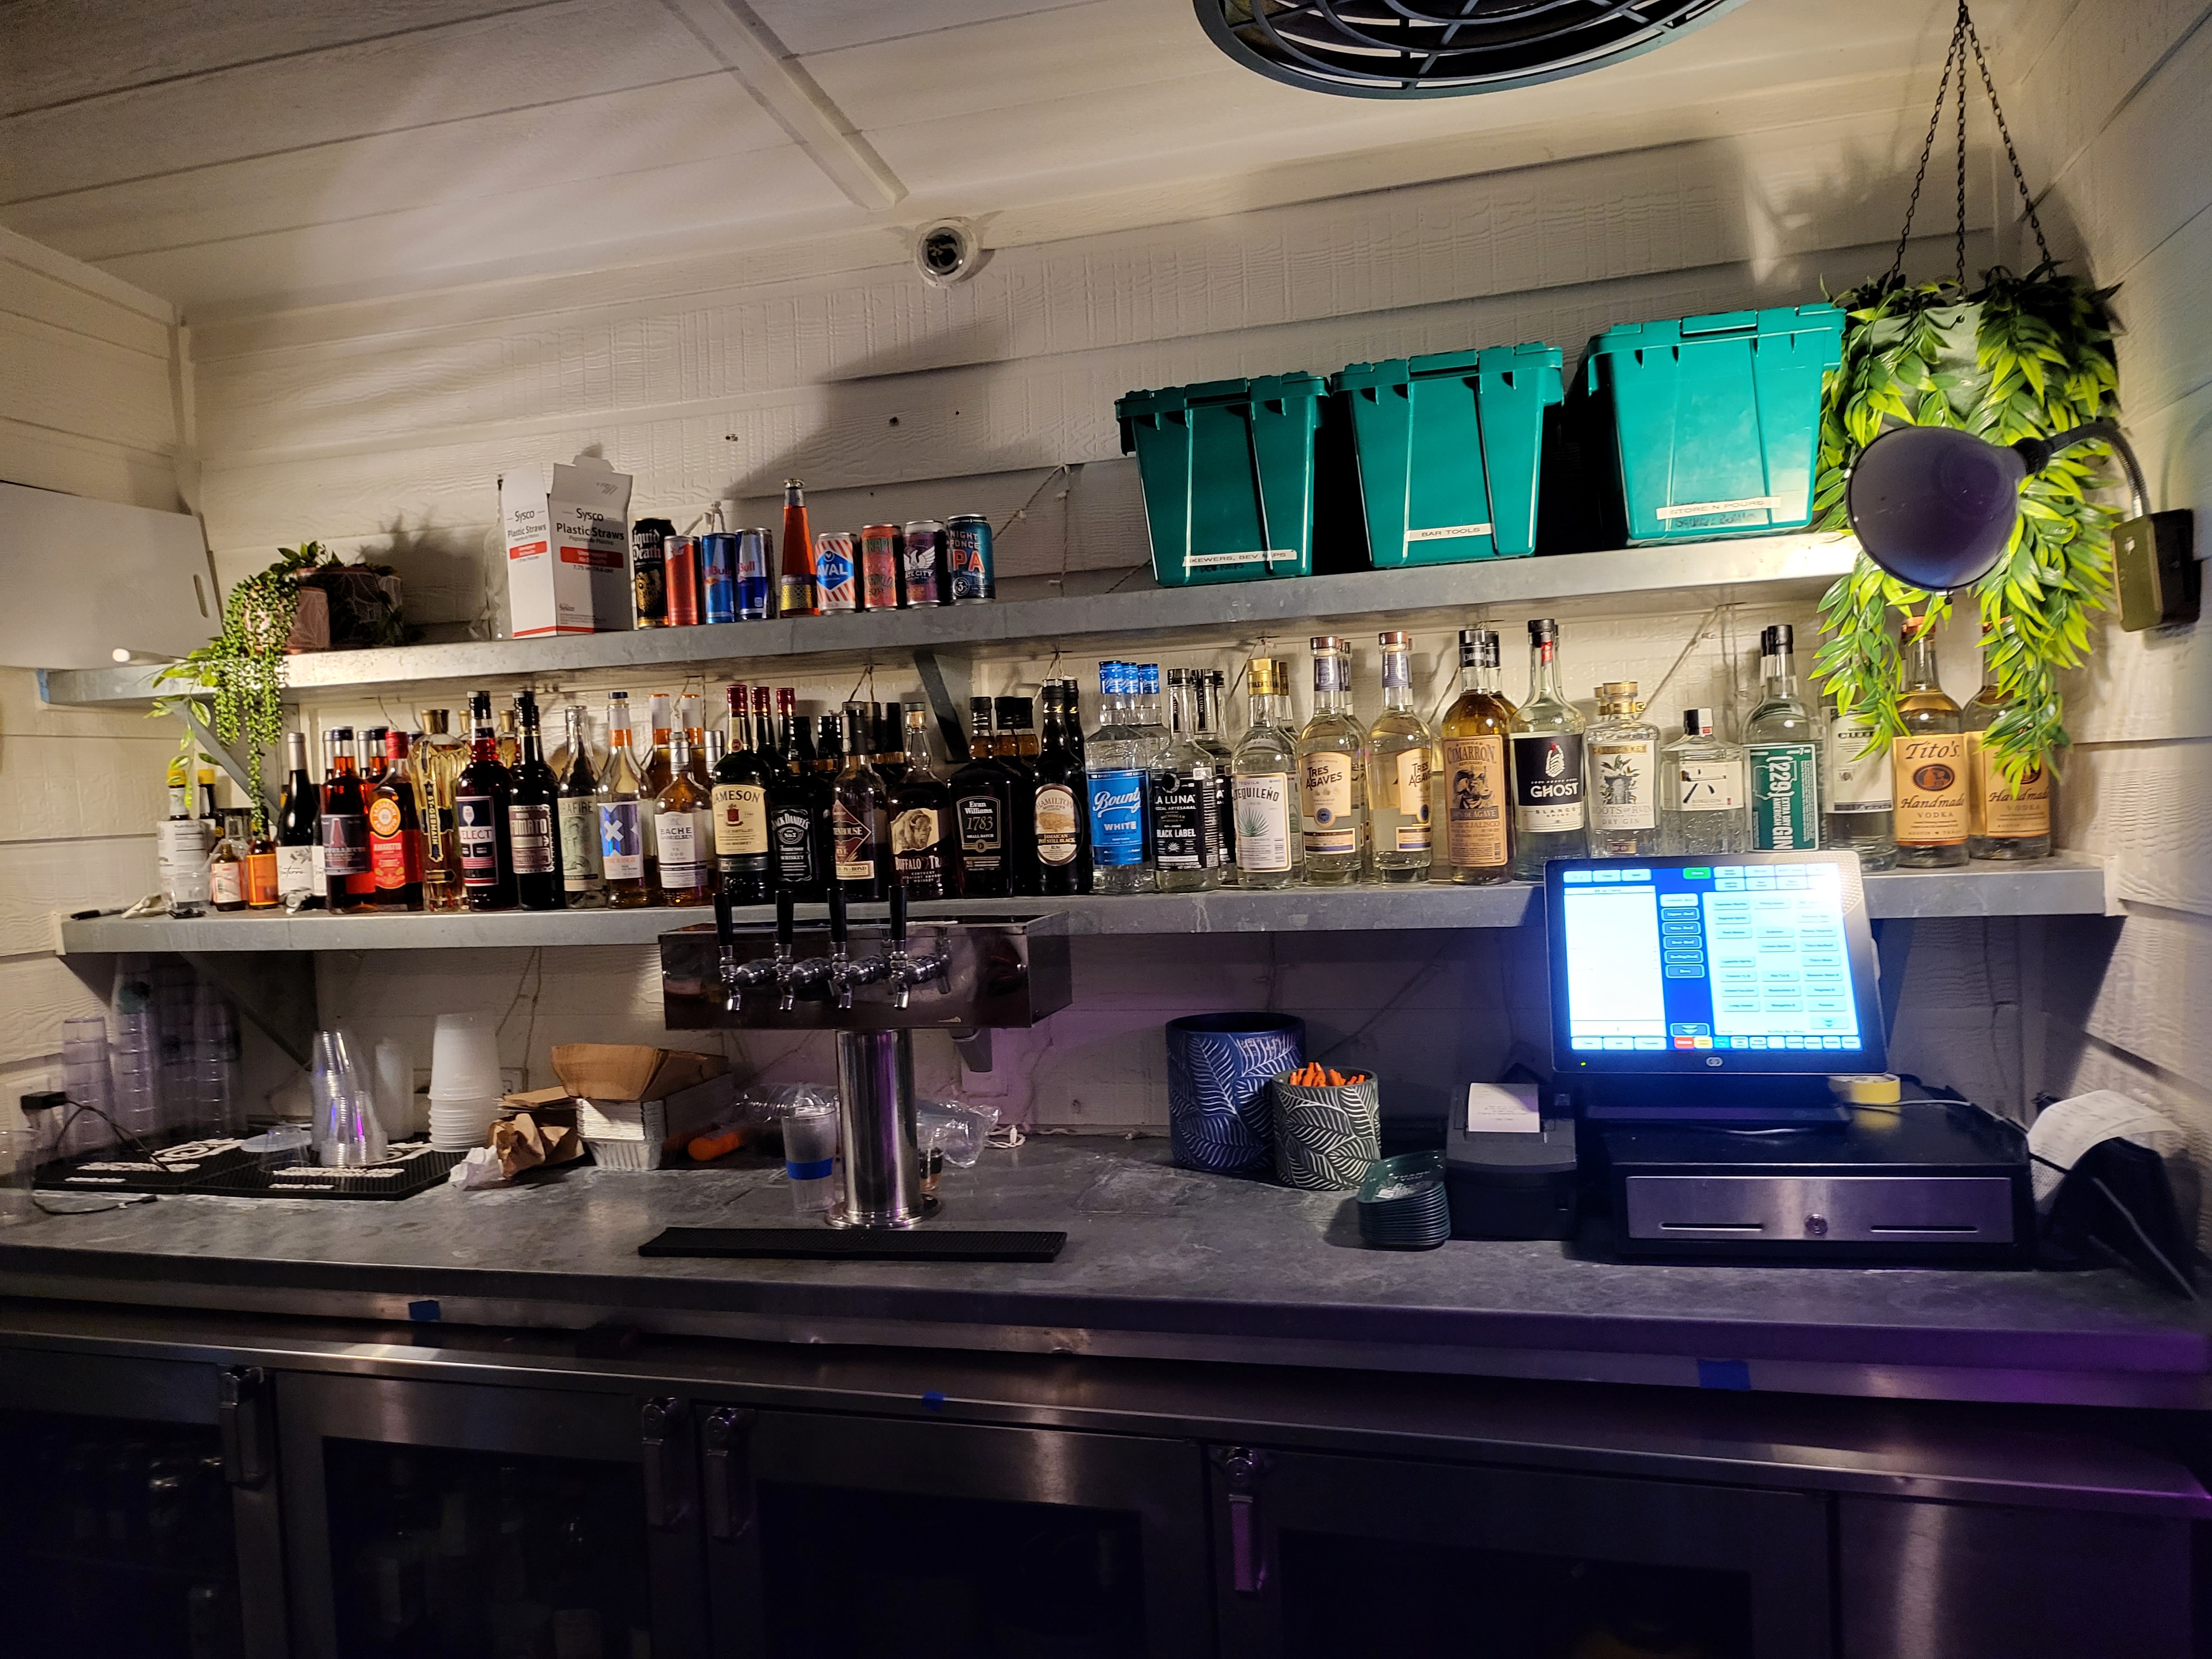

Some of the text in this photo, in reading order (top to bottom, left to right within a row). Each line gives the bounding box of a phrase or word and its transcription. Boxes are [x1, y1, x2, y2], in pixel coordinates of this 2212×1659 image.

[576, 508, 603, 521] Sysco
[1670, 506, 1708, 515] STORE
[1724, 500, 1765, 509] POURS
[515, 510, 535, 523] Sysco
[508, 528, 525, 538] Plastic
[526, 524, 546, 534] Straws
[556, 523, 624, 540] Plastic Straws
[950, 530, 978, 540] NIGHT
[950, 539, 981, 549] PONCE
[817, 563, 848, 577] AVAL
[905, 571, 914, 579] ATE
[1447, 745, 1497, 765] CIMARRON
[1905, 740, 1960, 759] Tito's
[1307, 765, 1328, 780] TRES
[1412, 761, 1429, 777] TRES
[1766, 756, 1795, 797] (229)
[1306, 772, 1343, 791] AGAVES
[1408, 771, 1431, 787] AGAV
[1680, 769, 1726, 804] 六
[1530, 782, 1579, 797] GHOST
[713, 790, 760, 805] JAMESON
[1036, 797, 1073, 810] HAMILTON
[1093, 787, 1141, 818] Bounty
[1165, 794, 1196, 804] LUNA
[1772, 797, 1781, 826] AMERICAN
[1782, 797, 1791, 827] EXTRA DRY
[784, 813, 810, 830] DANIEL'S
[966, 816, 993, 831] 1783
[1104, 821, 1137, 831] WHITE
[462, 830, 492, 839] ELECT
[660, 827, 692, 836] BACHE
[1156, 828, 1197, 837] BLACK LABEL
[1772, 827, 1793, 849] GIN
[895, 857, 922, 870] BUFFALO
